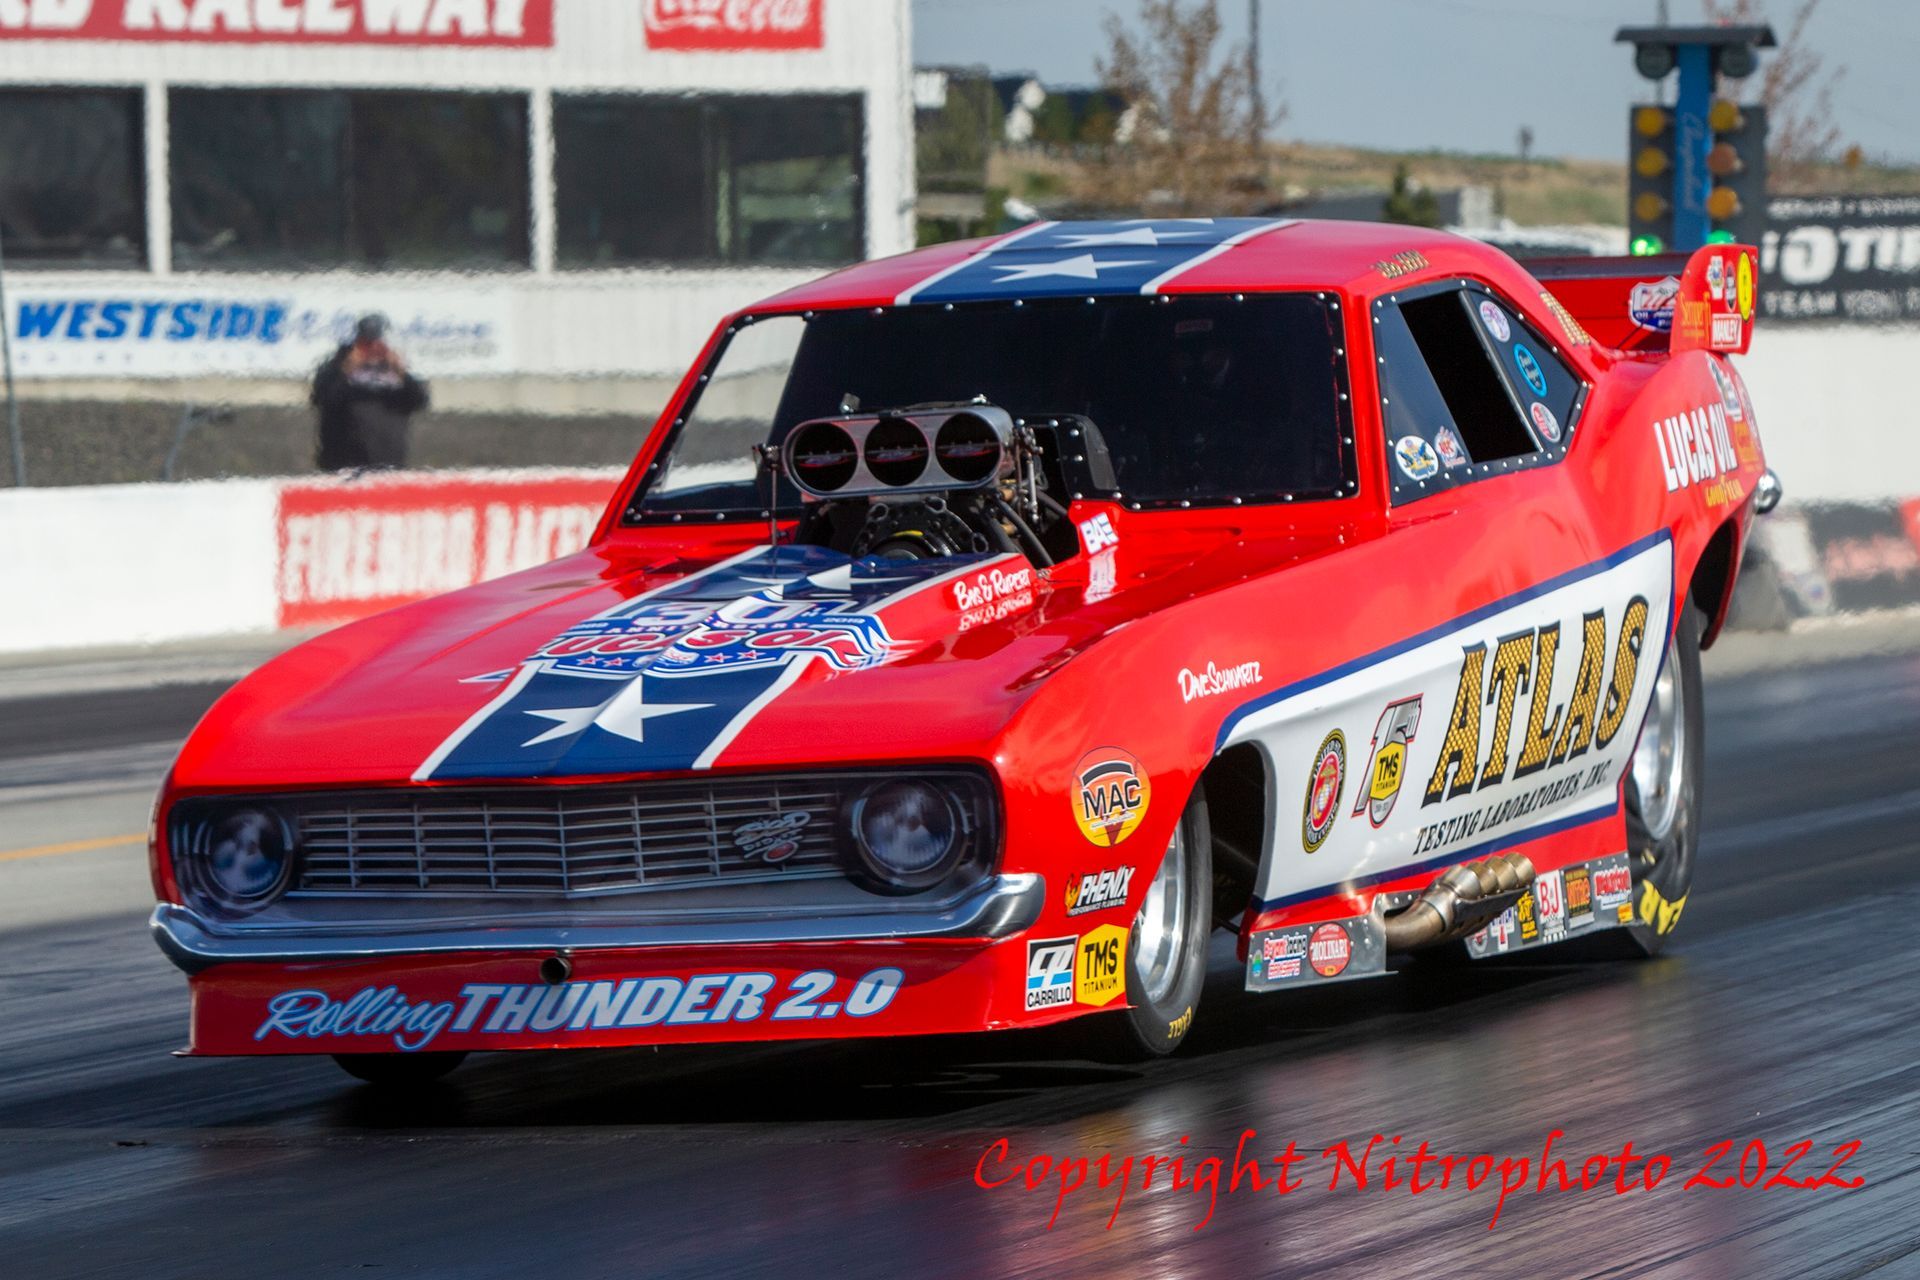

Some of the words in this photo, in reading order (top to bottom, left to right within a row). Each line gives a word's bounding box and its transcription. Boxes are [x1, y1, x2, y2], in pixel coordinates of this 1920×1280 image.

[15, 301, 292, 344] WESTSIDE
[1653, 406, 1717, 493] LUCAS
[1708, 402, 1739, 475] OIL
[1079, 512, 1119, 554] BAE
[1421, 594, 1649, 809] ATLAS
[1378, 752, 1400, 782] TMS
[1081, 777, 1142, 820] MAC
[1412, 805, 1481, 856] TESTING
[1076, 864, 1137, 907] PHENIX
[1084, 937, 1119, 980] TMS
[1027, 985, 1072, 1008] CARRILLO
[1084, 975, 1118, 994] TITANIUM
[255, 987, 454, 1052] Rolling
[448, 972, 777, 1034] THUNDER
[770, 967, 905, 1020] 2.0
